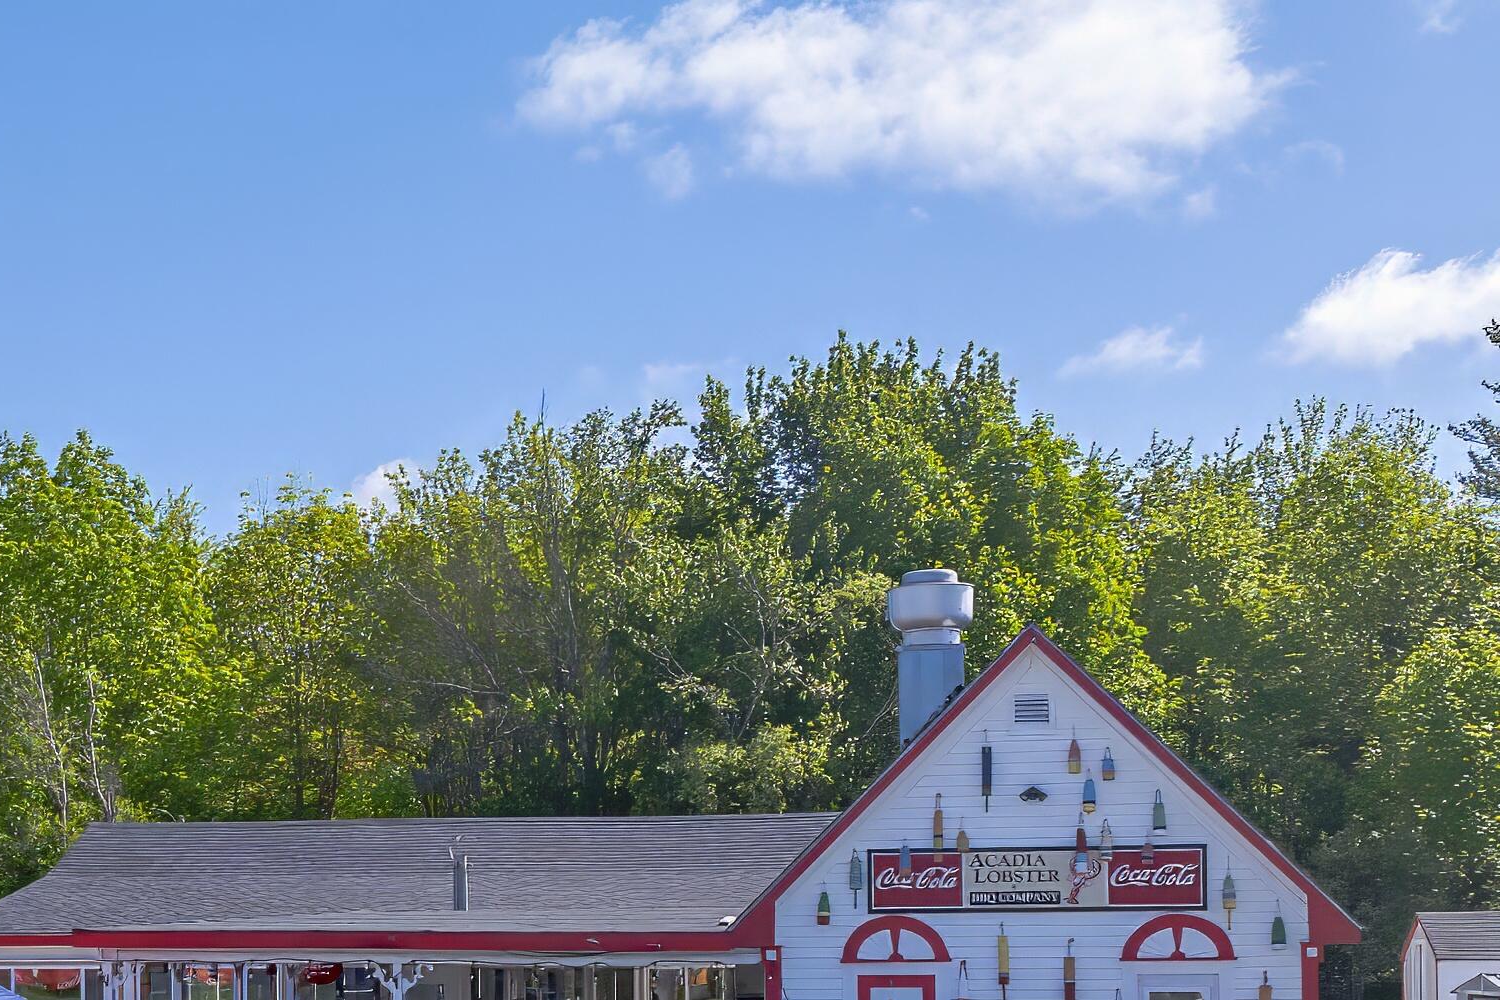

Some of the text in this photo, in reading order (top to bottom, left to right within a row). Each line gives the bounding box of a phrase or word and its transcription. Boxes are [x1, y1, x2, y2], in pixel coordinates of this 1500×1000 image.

[968, 853, 1046, 868] ACADIA
[974, 869, 1060, 884] LOBSTER
[1110, 863, 1199, 887] Coca-Cola
